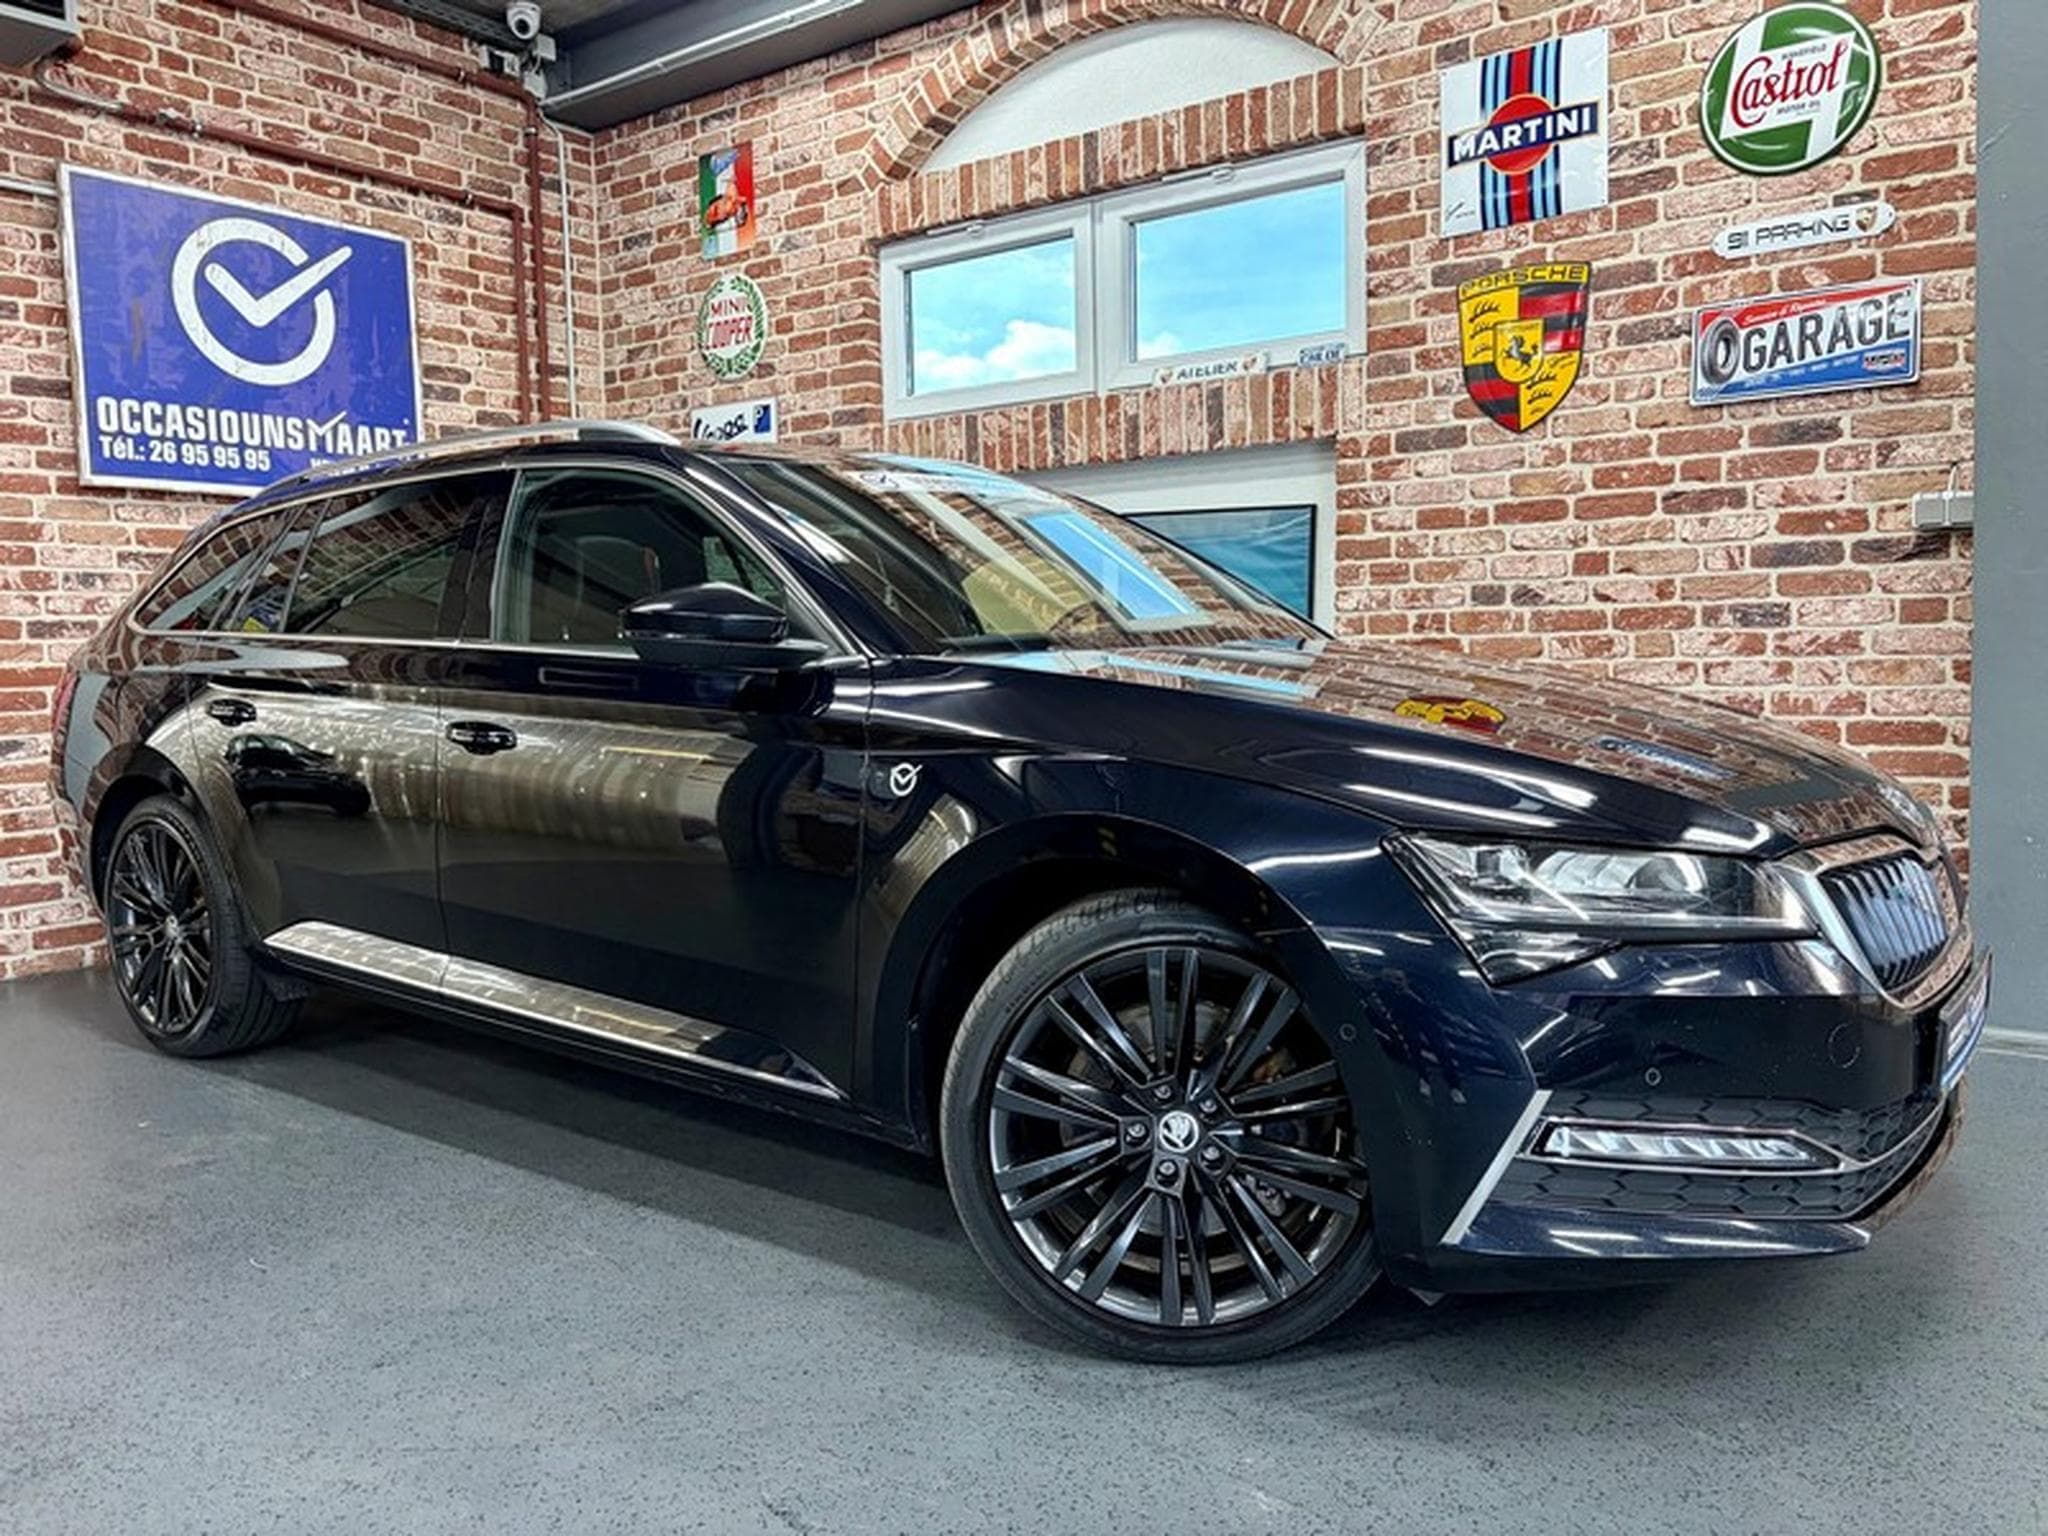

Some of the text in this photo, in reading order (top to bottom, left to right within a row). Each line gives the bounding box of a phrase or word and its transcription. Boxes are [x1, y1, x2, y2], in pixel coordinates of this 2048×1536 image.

[1731, 38, 1849, 129] Castrol
[1453, 107, 1591, 162] MARTINI
[1755, 214, 1850, 246] PARKING
[1461, 264, 1585, 297] PORSCHE
[97, 396, 407, 456] OCCASIOUNSMAART
[98, 434, 271, 472] Tél.: 26 95 95 95
